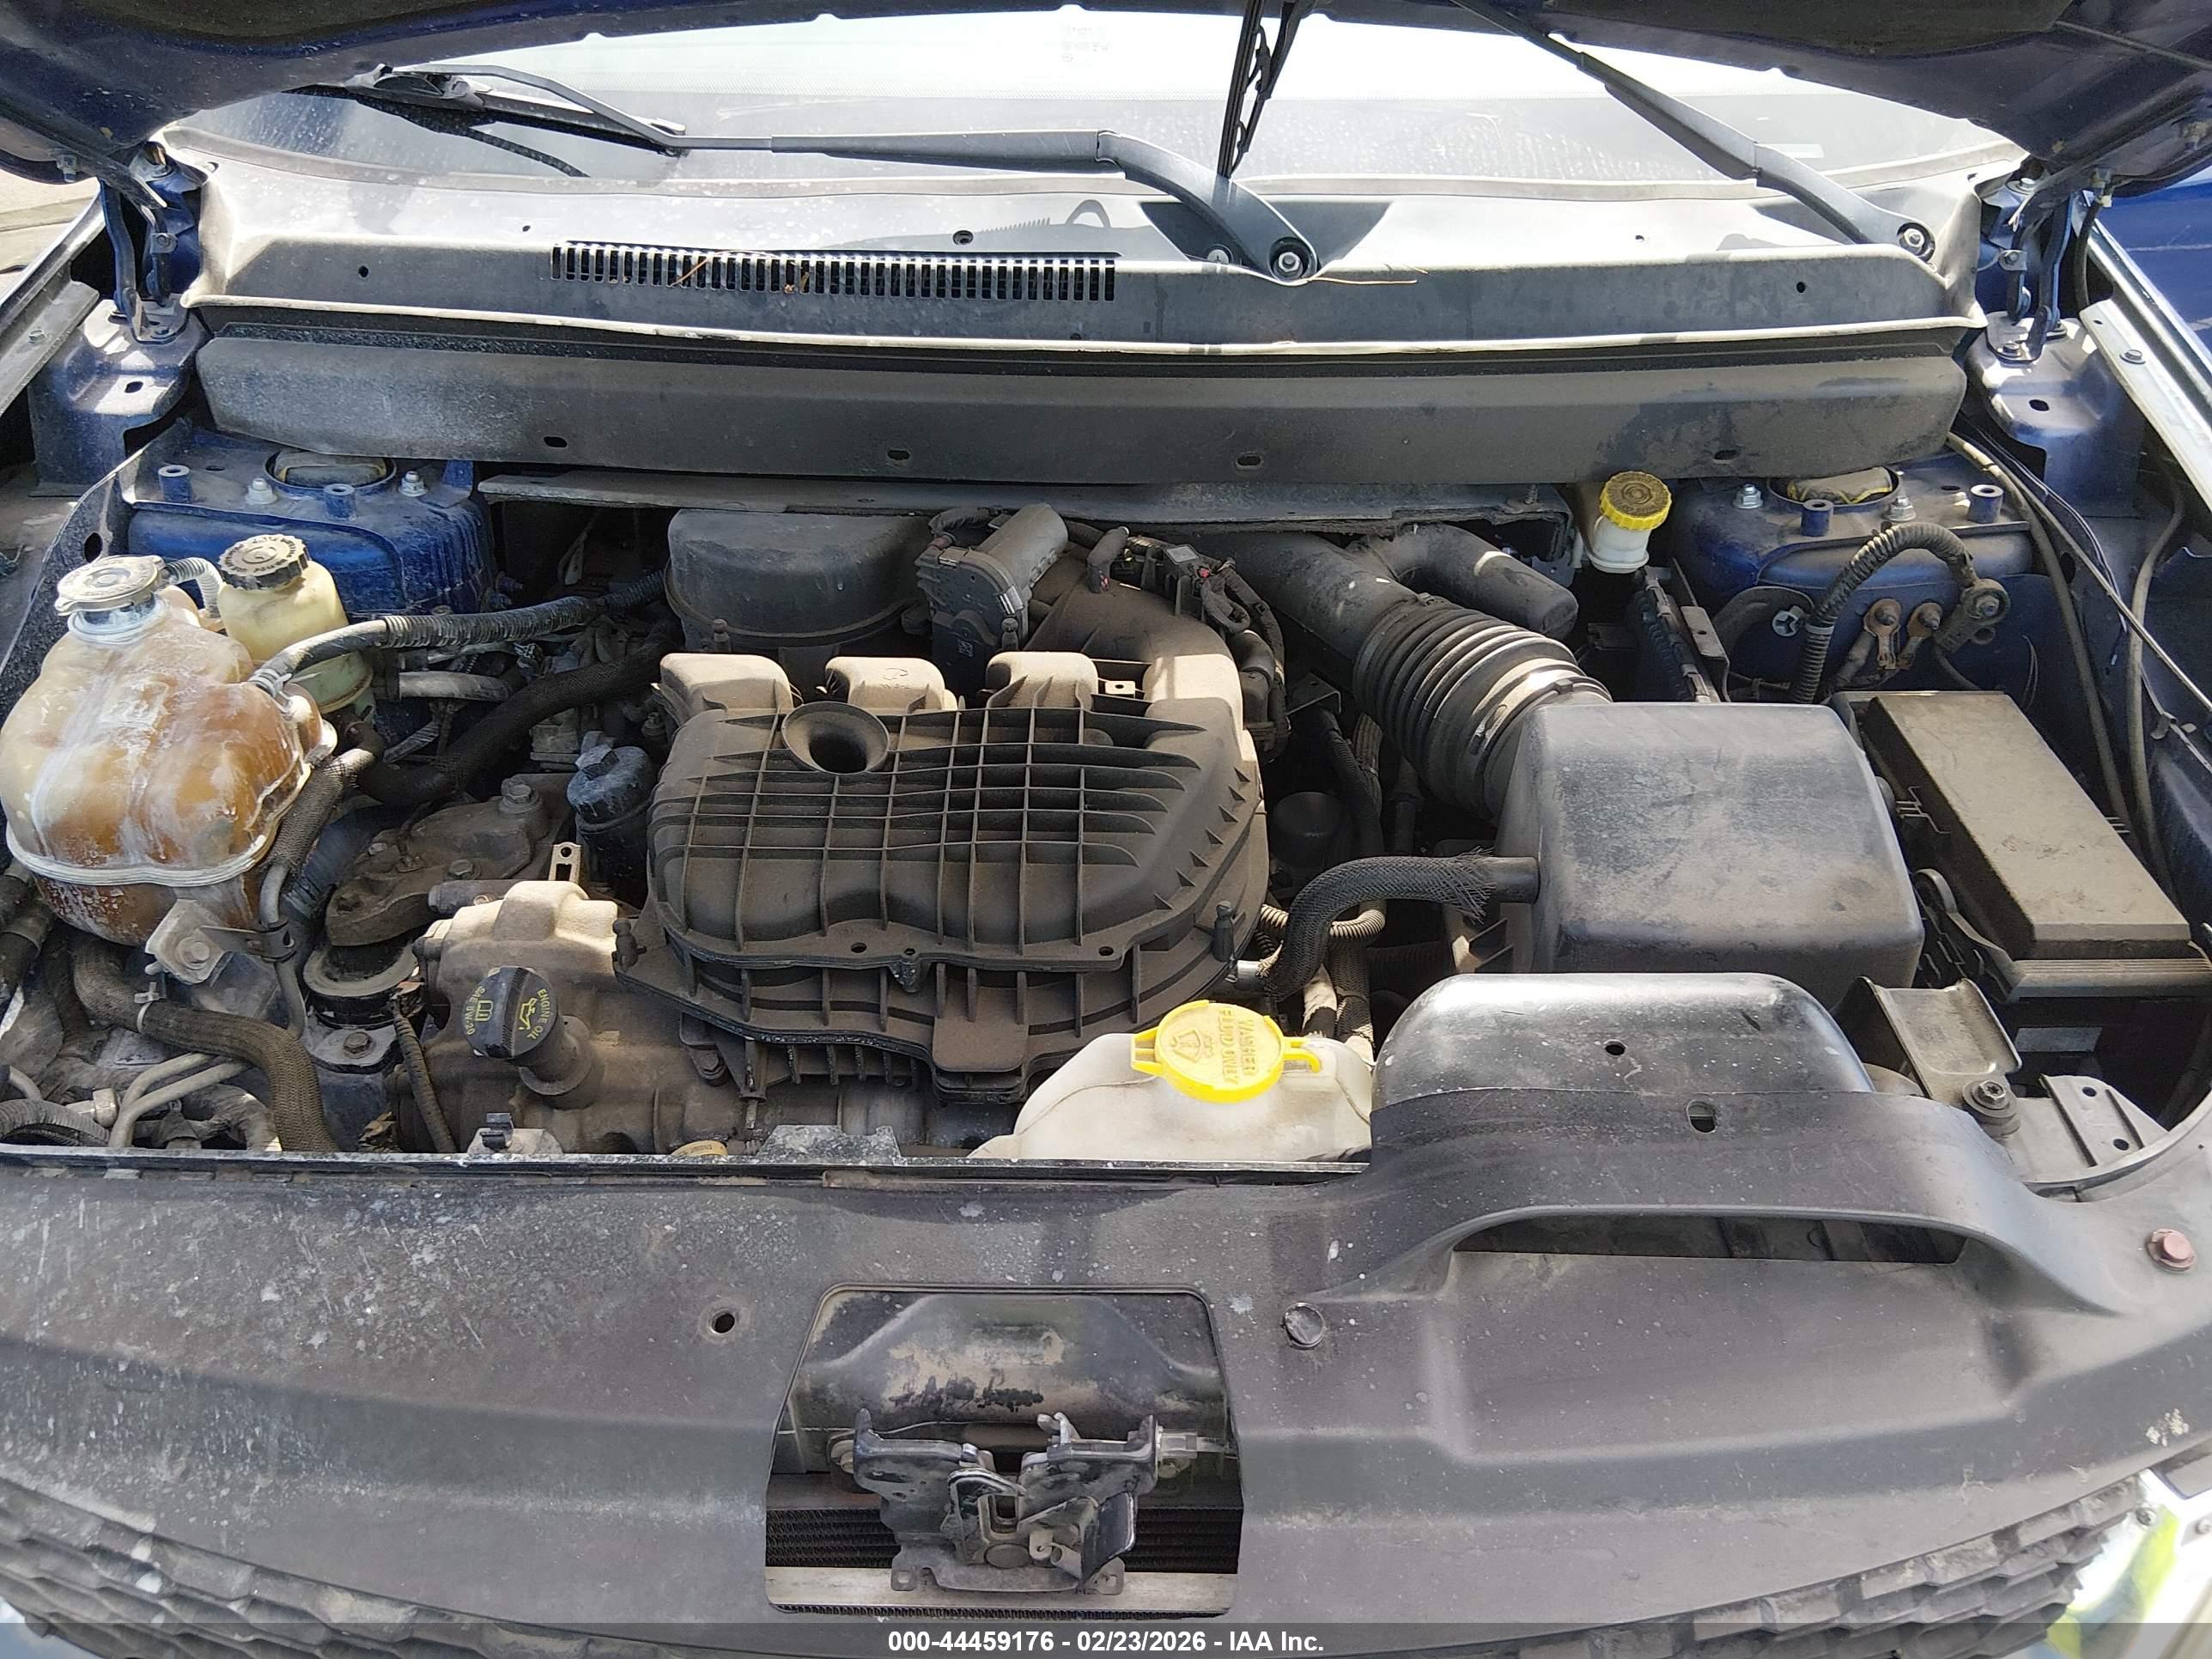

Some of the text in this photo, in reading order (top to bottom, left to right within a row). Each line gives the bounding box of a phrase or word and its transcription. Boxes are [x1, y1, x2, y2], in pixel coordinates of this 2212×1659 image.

[469, 986, 486, 1004] SAE
[526, 988, 550, 1040] ENGINE OIL
[1218, 1007, 1239, 1085] FLUID ONLY
[1237, 1018, 1258, 1076] WASHER
